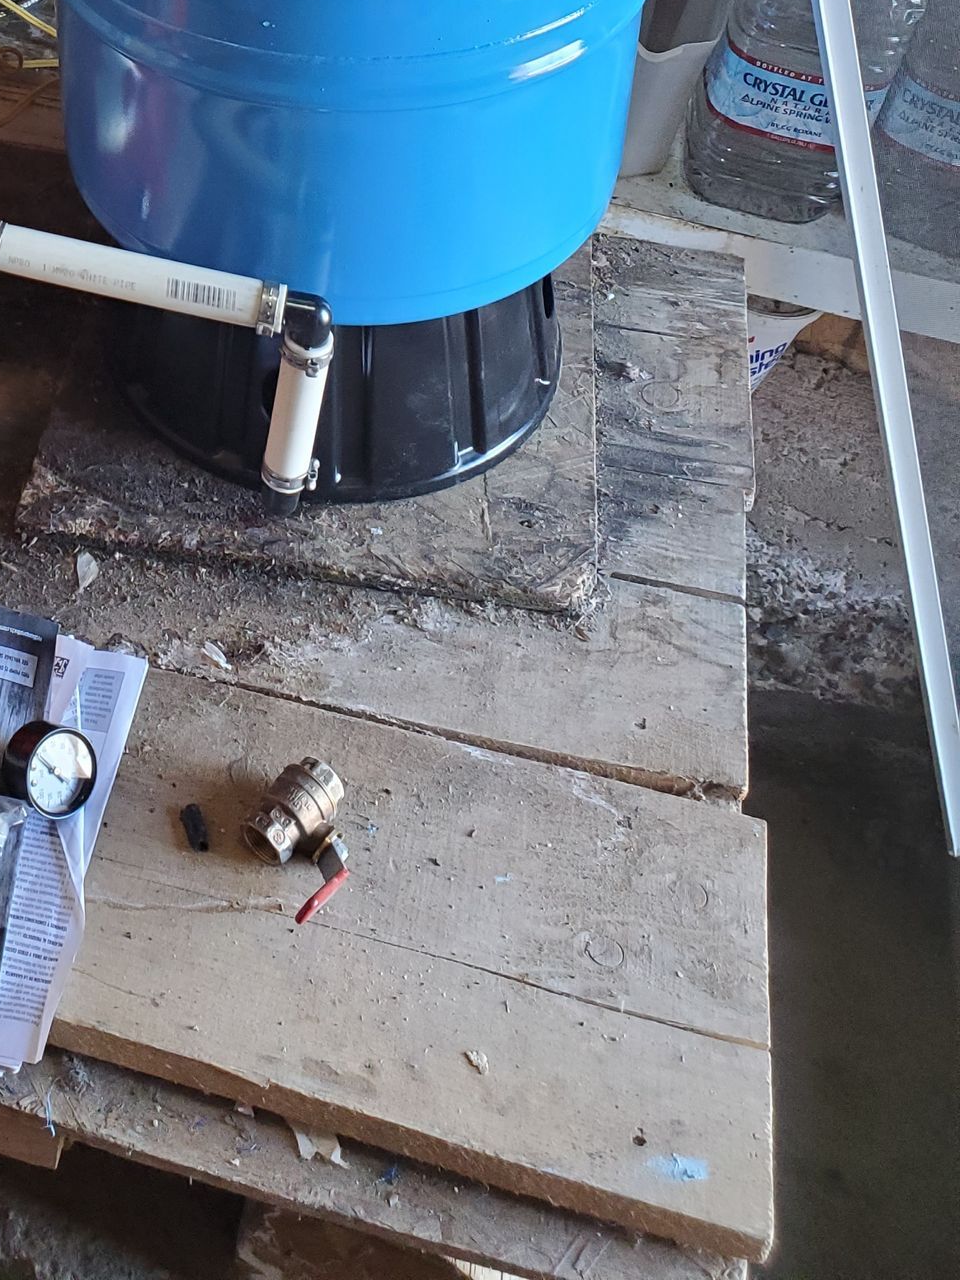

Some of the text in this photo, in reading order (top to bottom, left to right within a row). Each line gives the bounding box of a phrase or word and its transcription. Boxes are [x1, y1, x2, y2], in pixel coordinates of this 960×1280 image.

[756, 61, 795, 77] BOTTLED
[743, 73, 806, 102] CRYSTAL
[739, 94, 781, 113] ALPINE
[782, 108, 823, 122] SPRING
[4, 654, 21, 663] VOLTAGE
[8, 668, 21, 676] PUMP
